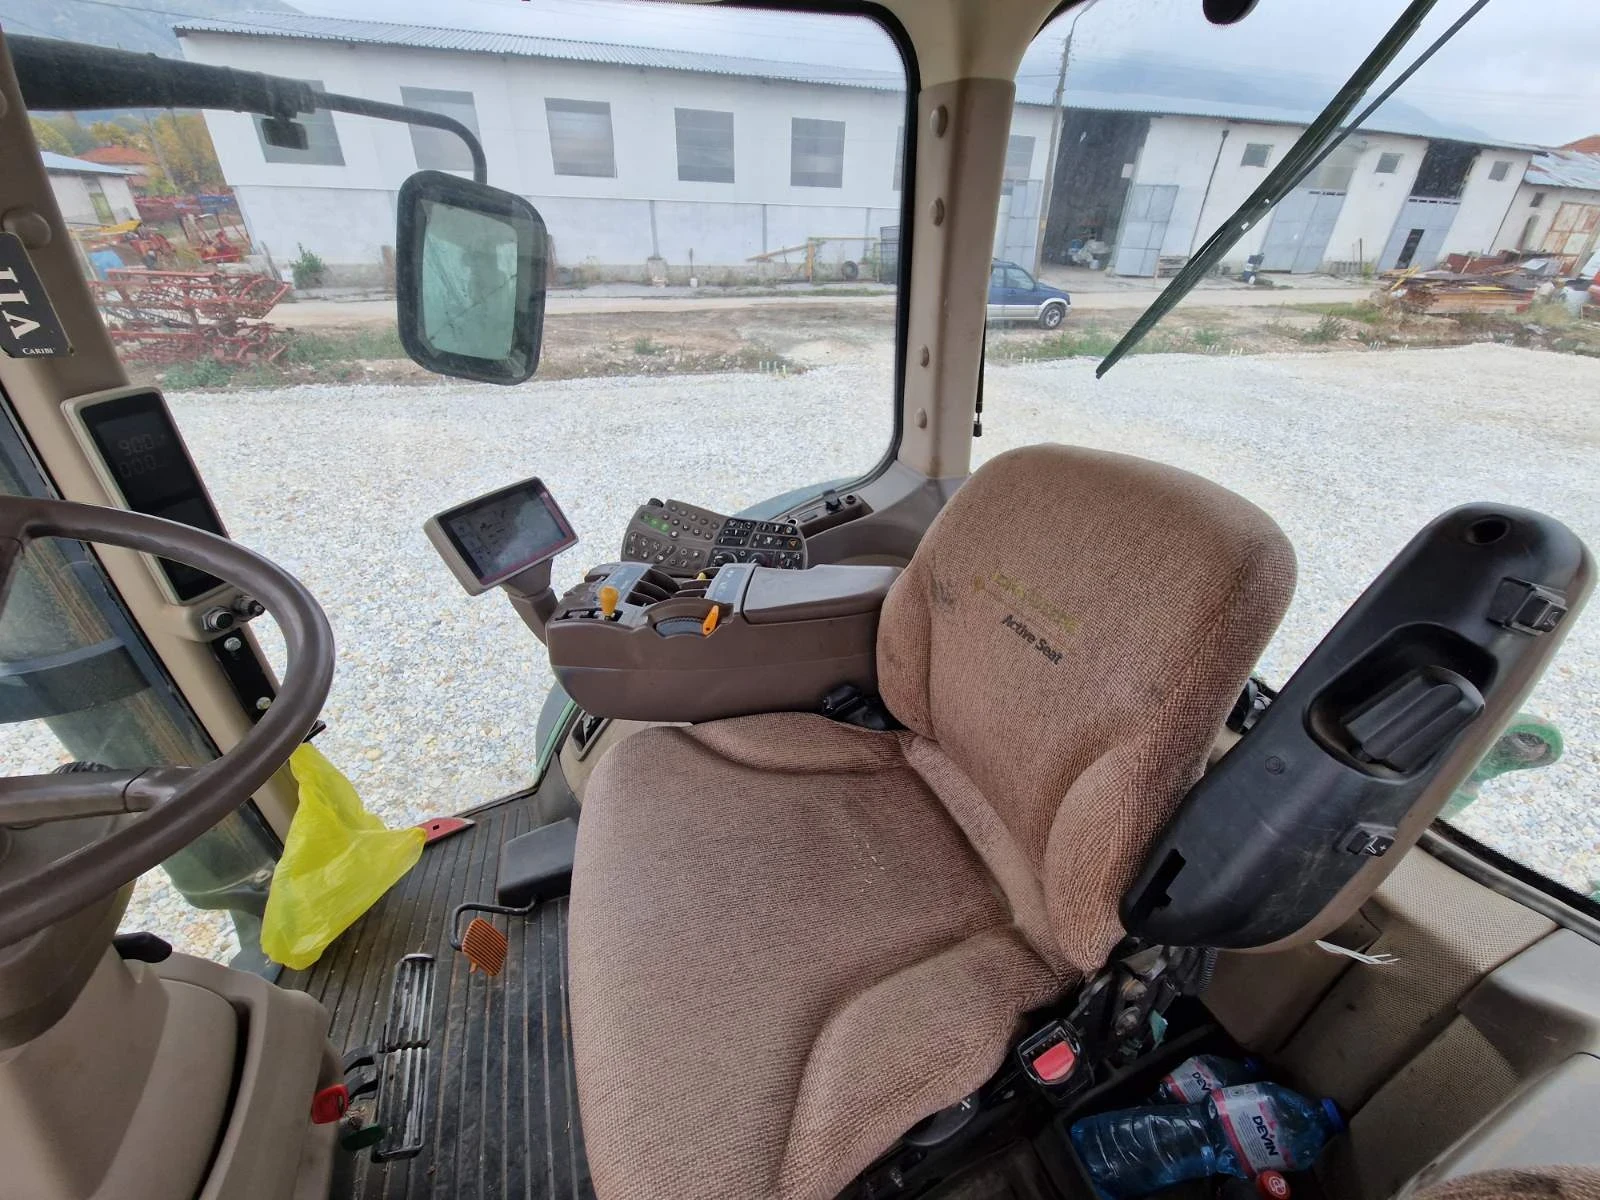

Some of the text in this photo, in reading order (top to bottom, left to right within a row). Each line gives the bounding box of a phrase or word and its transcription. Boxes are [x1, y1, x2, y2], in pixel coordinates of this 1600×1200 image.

[1001, 614, 1063, 665] Active Seat
[1253, 1116, 1279, 1156] DEVIN
